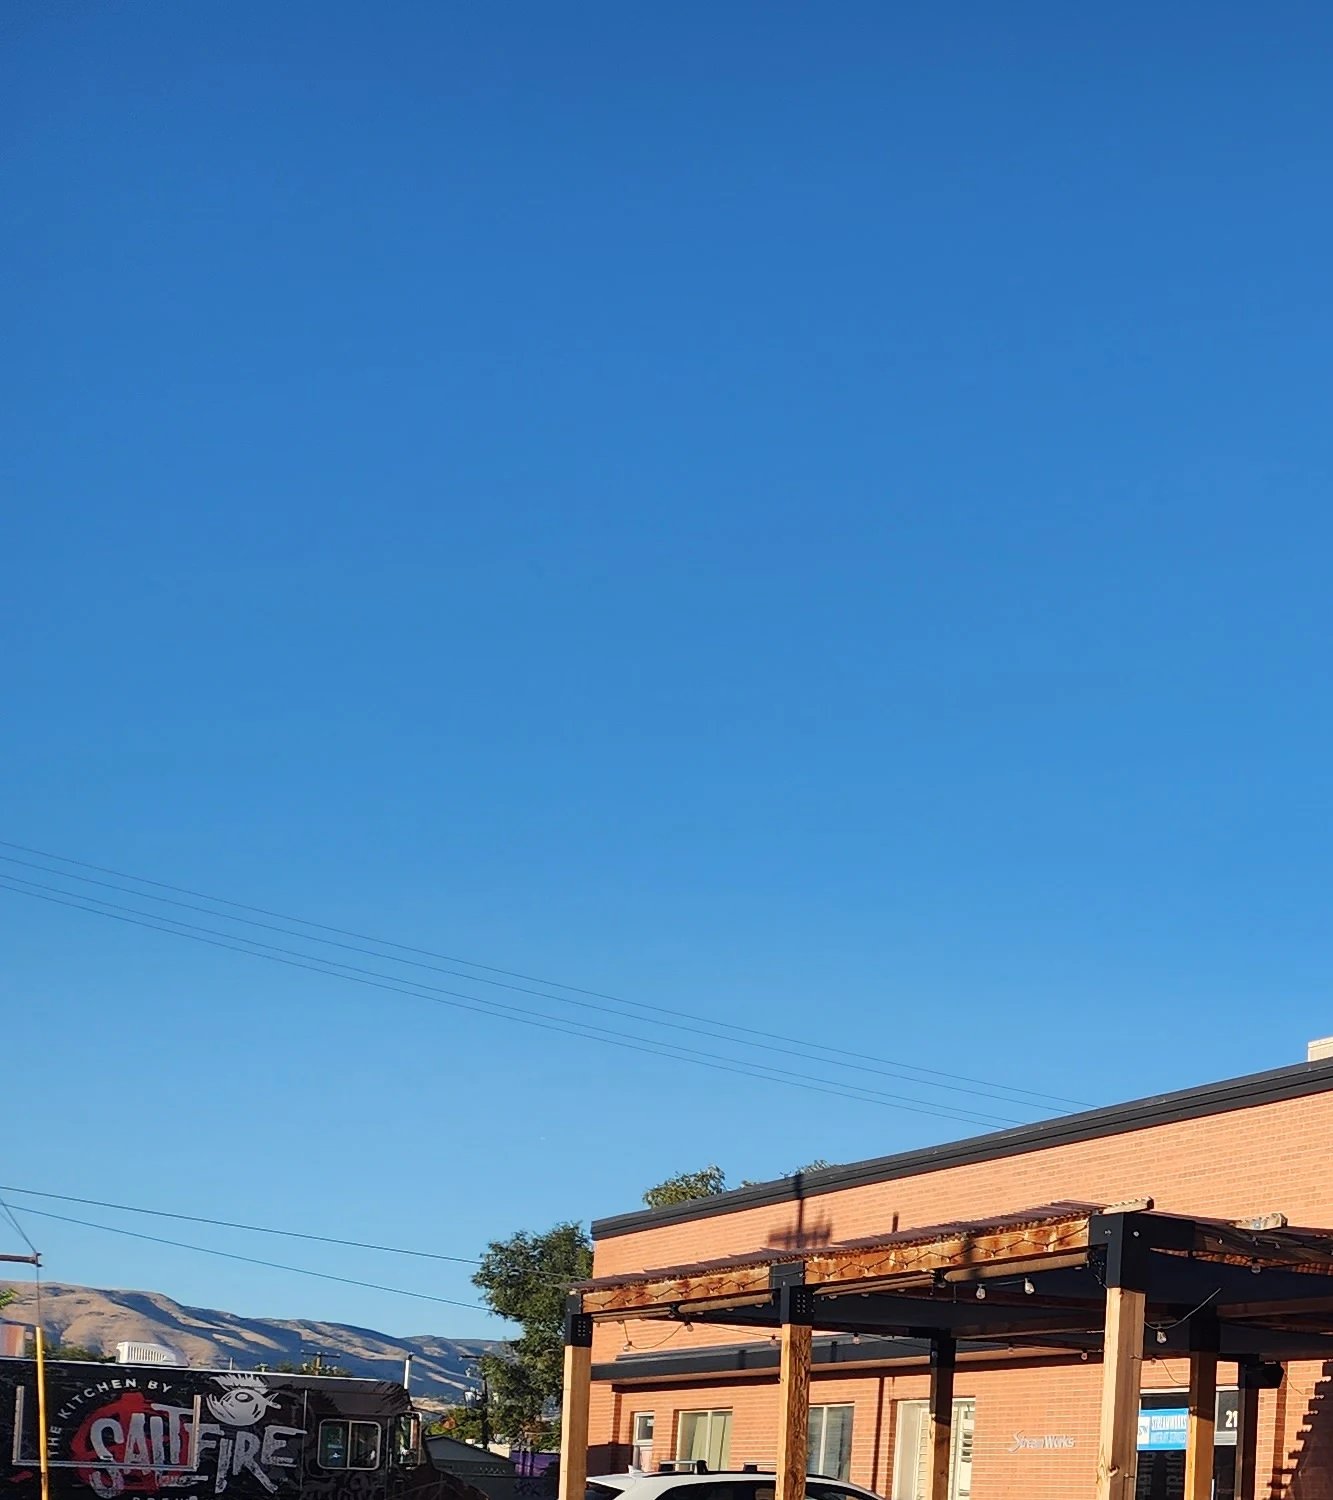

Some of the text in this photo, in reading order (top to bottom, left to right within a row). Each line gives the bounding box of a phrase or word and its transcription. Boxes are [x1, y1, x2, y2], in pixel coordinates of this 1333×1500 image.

[48, 1378, 173, 1456] THE KITCHEN BY
